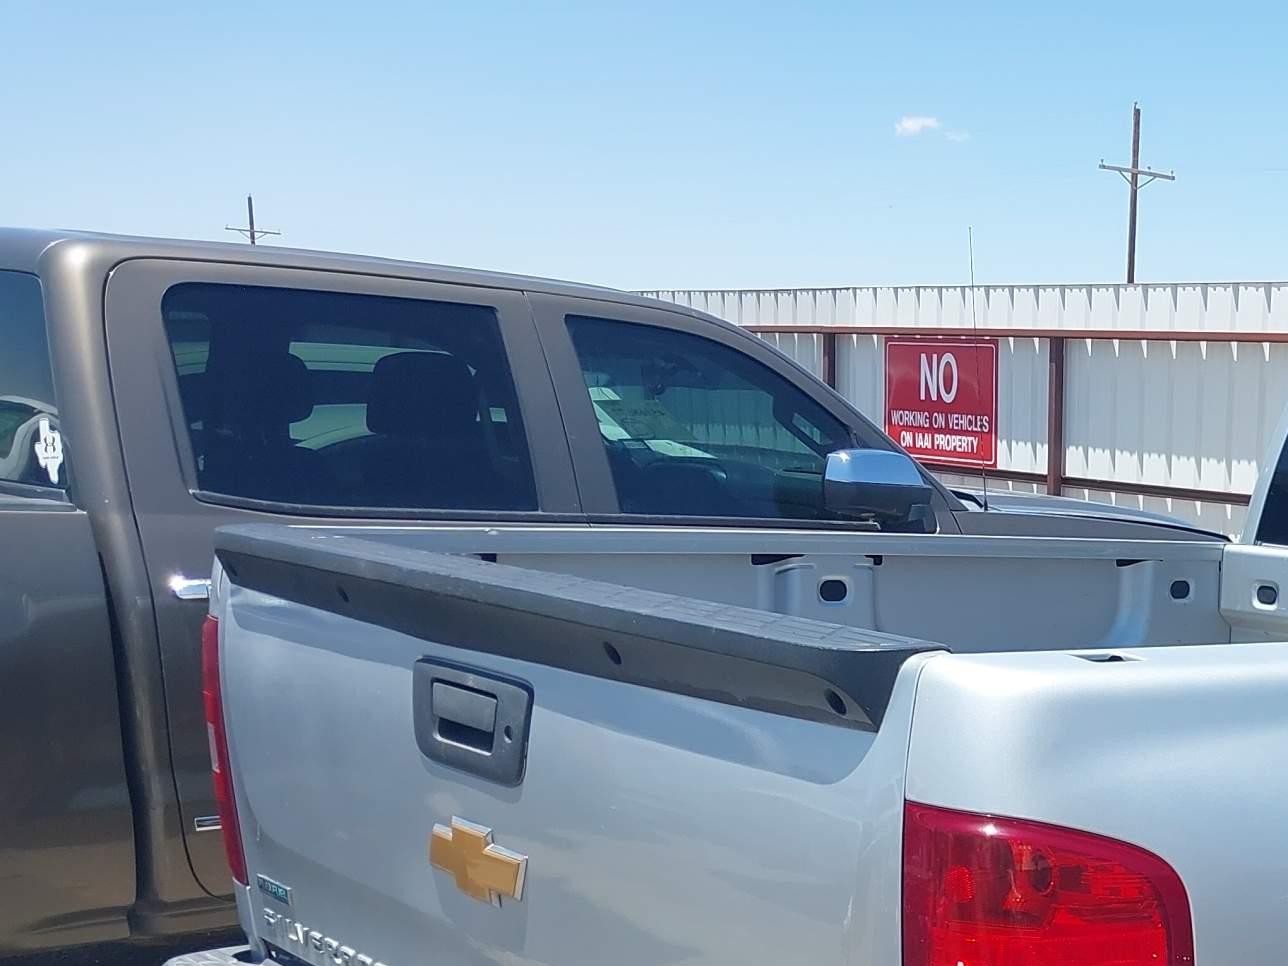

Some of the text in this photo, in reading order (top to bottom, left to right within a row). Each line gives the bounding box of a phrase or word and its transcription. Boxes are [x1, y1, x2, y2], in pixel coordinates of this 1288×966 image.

[920, 352, 958, 403] NO
[891, 410, 990, 432] WORKING ON VEHICLES
[900, 431, 978, 453] ON IAAI PROPERTY
